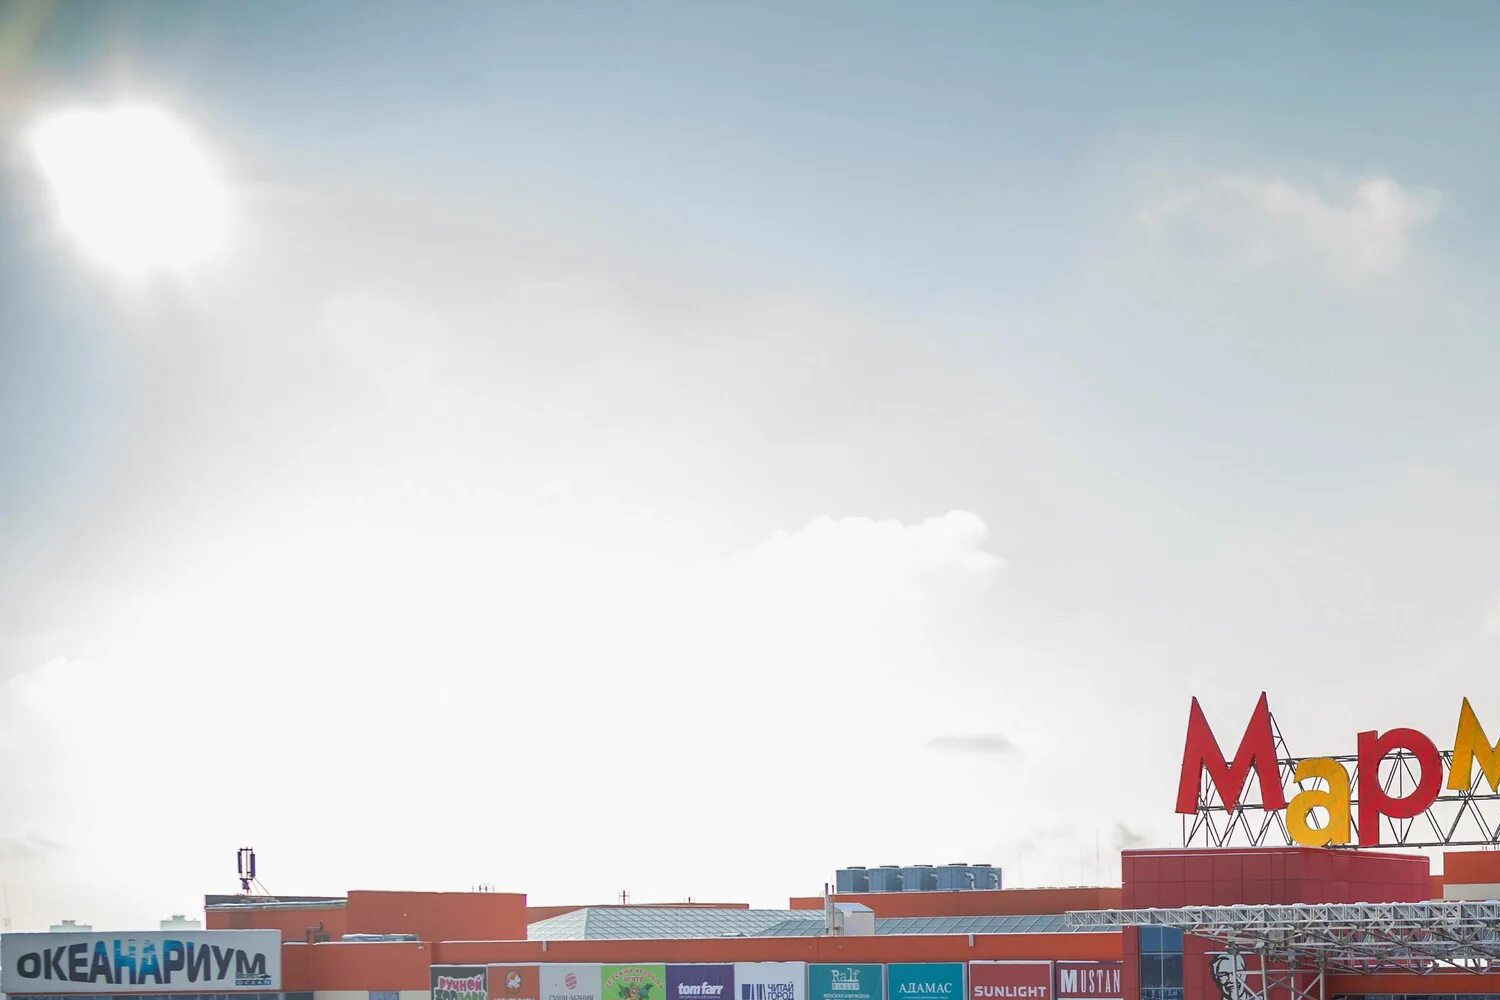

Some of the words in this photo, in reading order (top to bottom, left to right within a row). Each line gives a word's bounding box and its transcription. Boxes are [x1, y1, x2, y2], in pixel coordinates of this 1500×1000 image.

[17, 939, 267, 985] ОКЕАНАРИУМ
[831, 967, 860, 982] Ralf
[438, 975, 484, 991] РУЧНОЙ
[767, 981, 794, 992] ЧИТАЙ
[899, 983, 953, 994] АДАМАС
[974, 986, 1047, 998] SUNLIGHT
